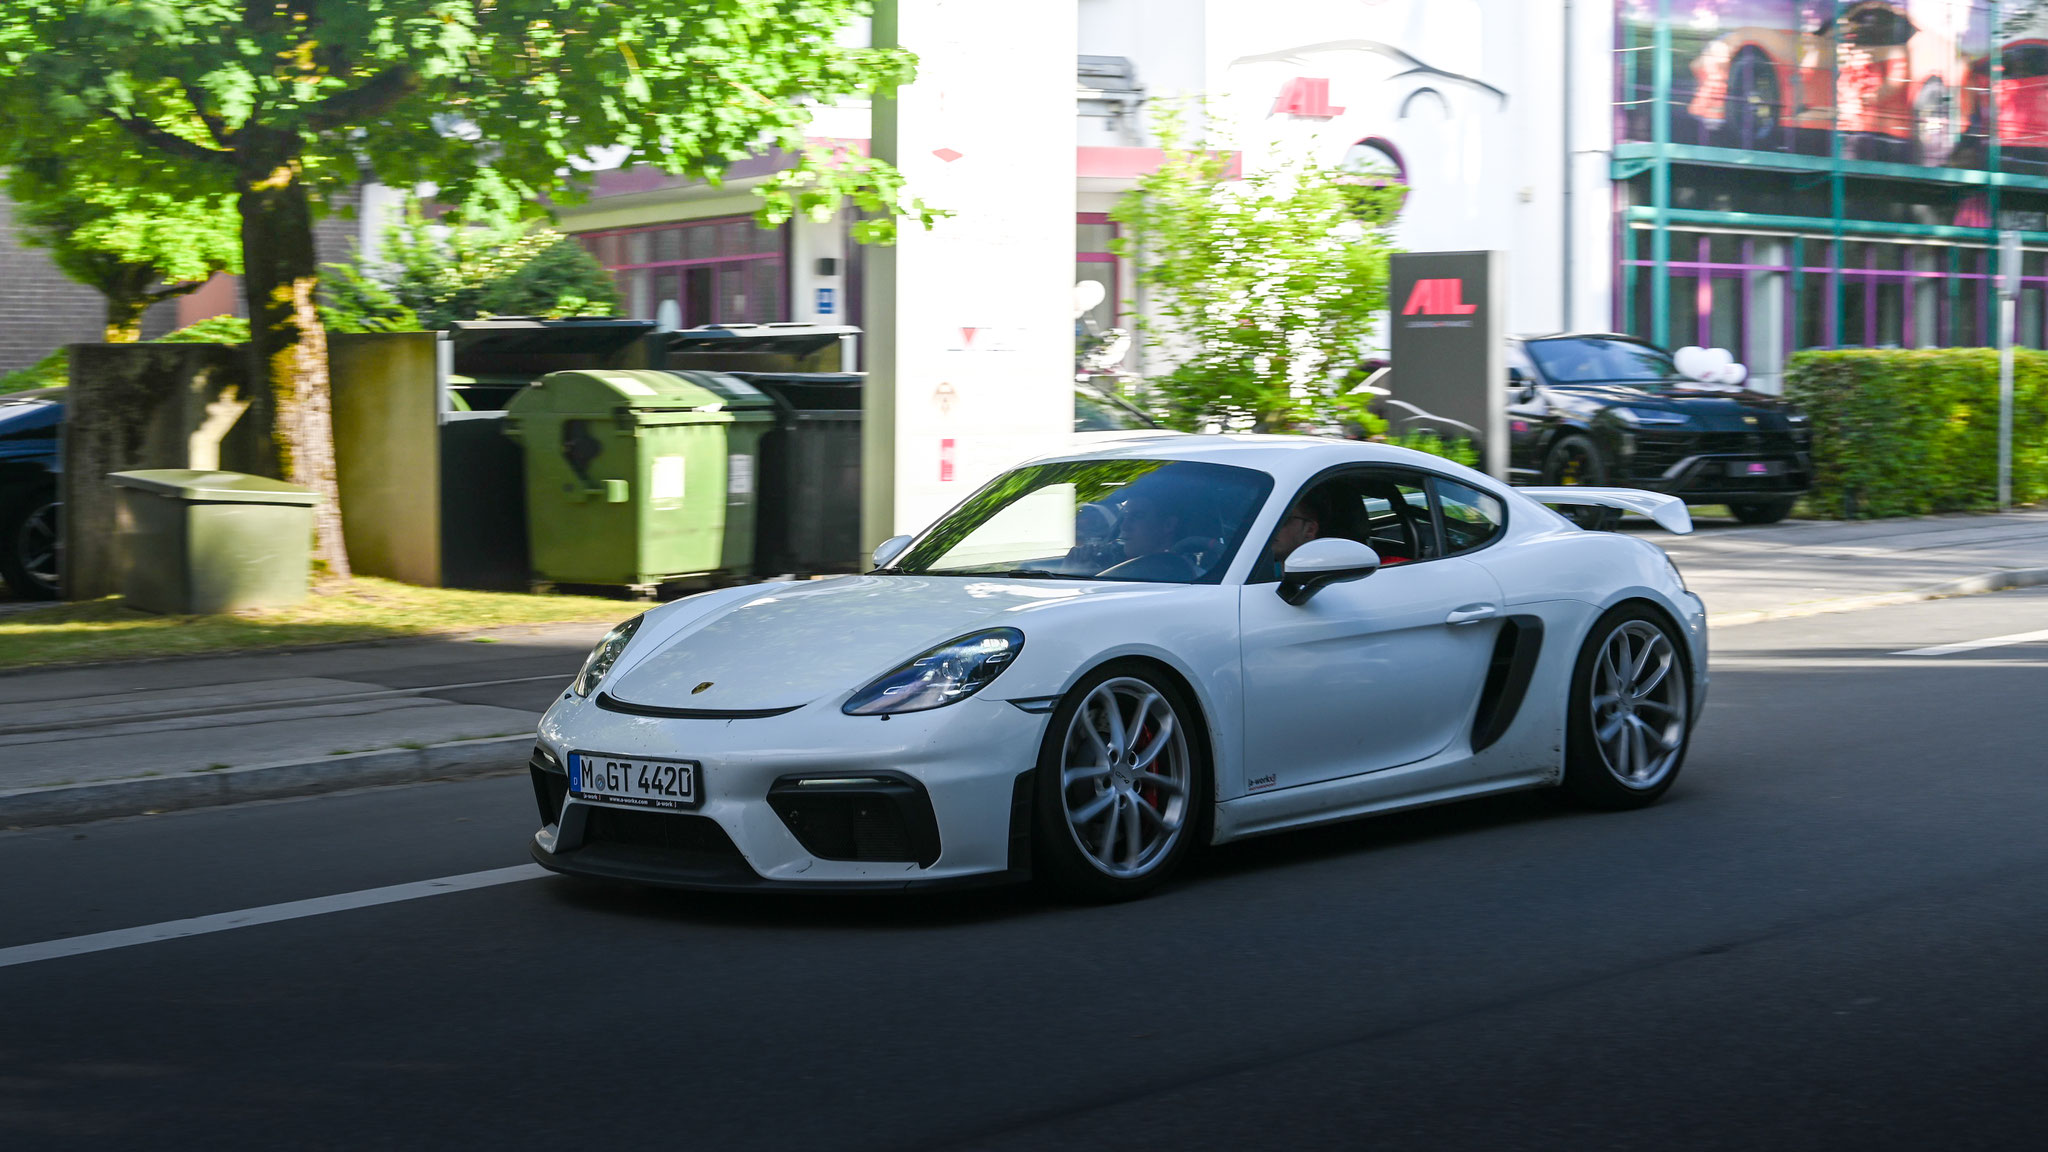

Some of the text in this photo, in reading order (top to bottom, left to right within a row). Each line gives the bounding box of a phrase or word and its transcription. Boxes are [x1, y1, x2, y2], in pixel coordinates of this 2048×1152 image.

[1401, 278, 1478, 315] AIL
[582, 760, 692, 796] M GT 4420
